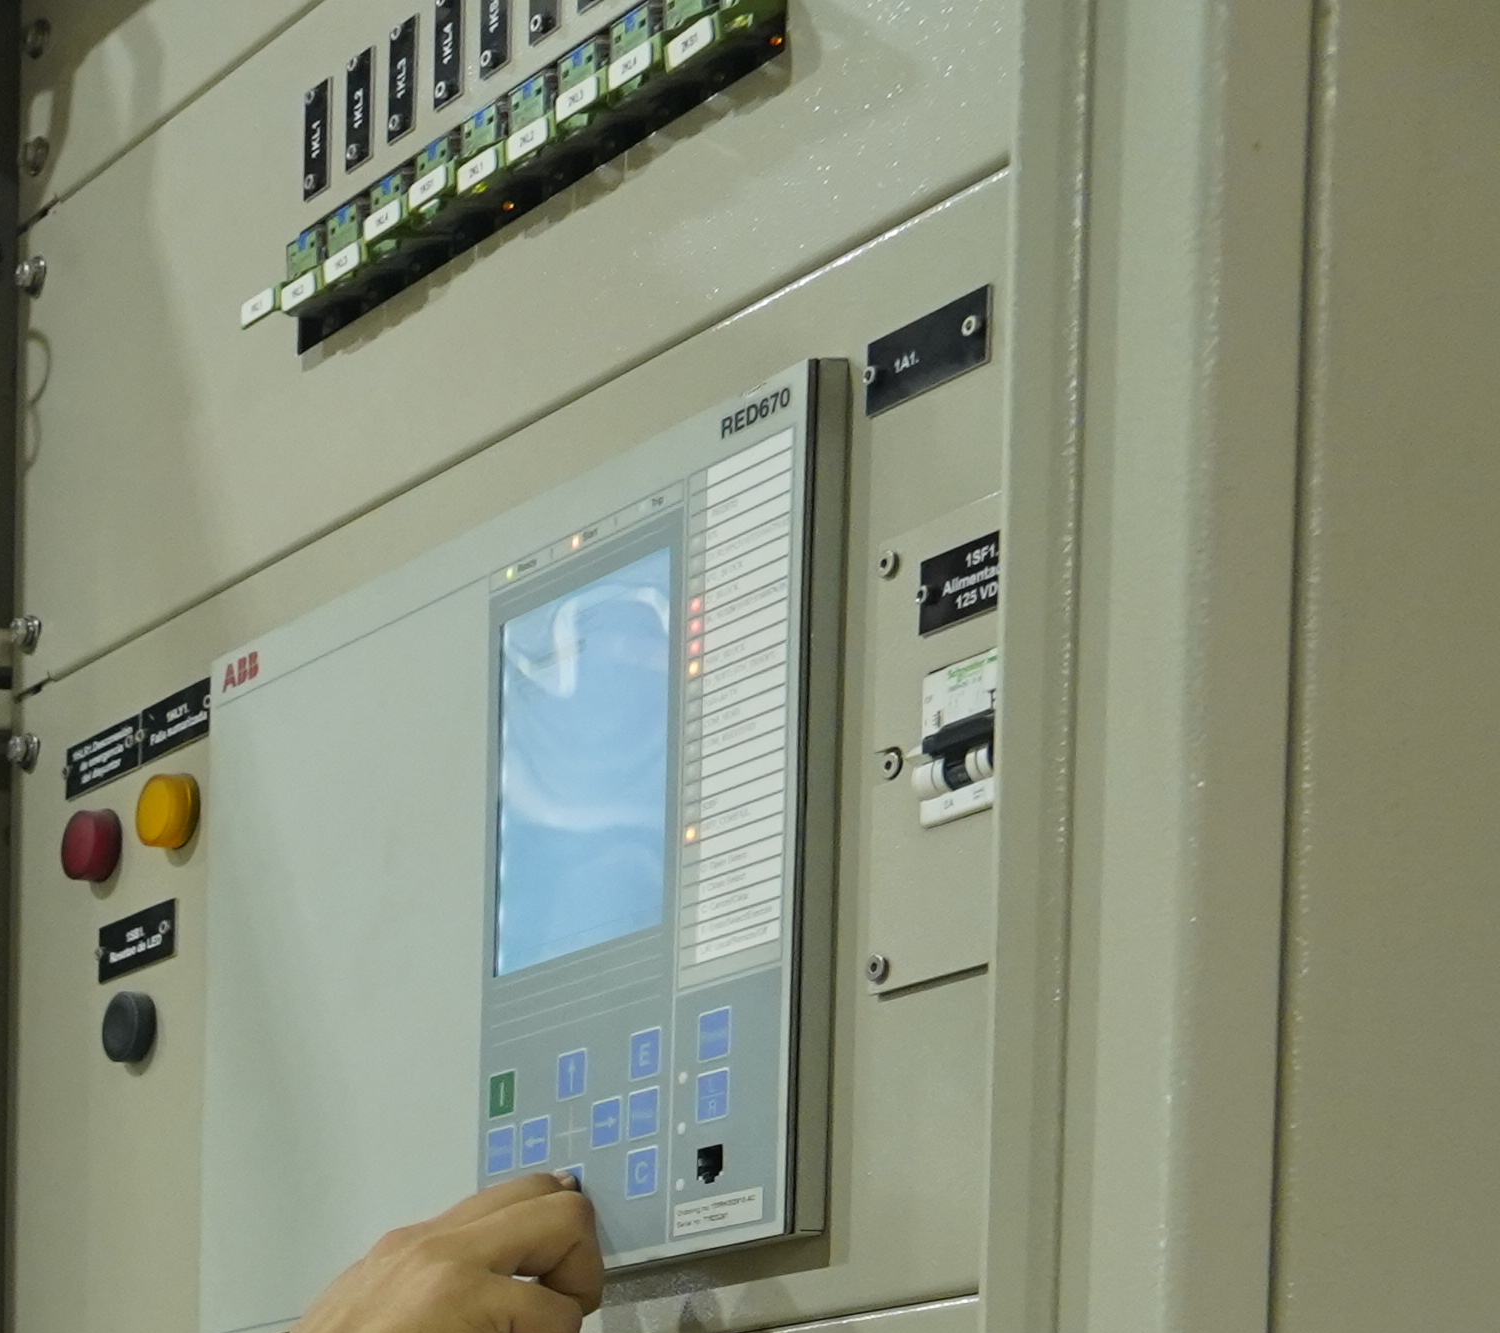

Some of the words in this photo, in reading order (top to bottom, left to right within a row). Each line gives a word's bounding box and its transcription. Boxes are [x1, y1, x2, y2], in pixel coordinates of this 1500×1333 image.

[443, 22, 453, 65] 1KL4
[396, 57, 407, 99] 1KL3
[353, 88, 364, 129] 1KL2
[311, 120, 321, 158] 1KL1
[721, 387, 792, 439] RED670
[965, 544, 1000, 569] 1SF1.
[955, 587, 978, 610] 125
[222, 651, 260, 693] ABB
[146, 933, 163, 950] LED
[634, 1161, 648, 1184] C
